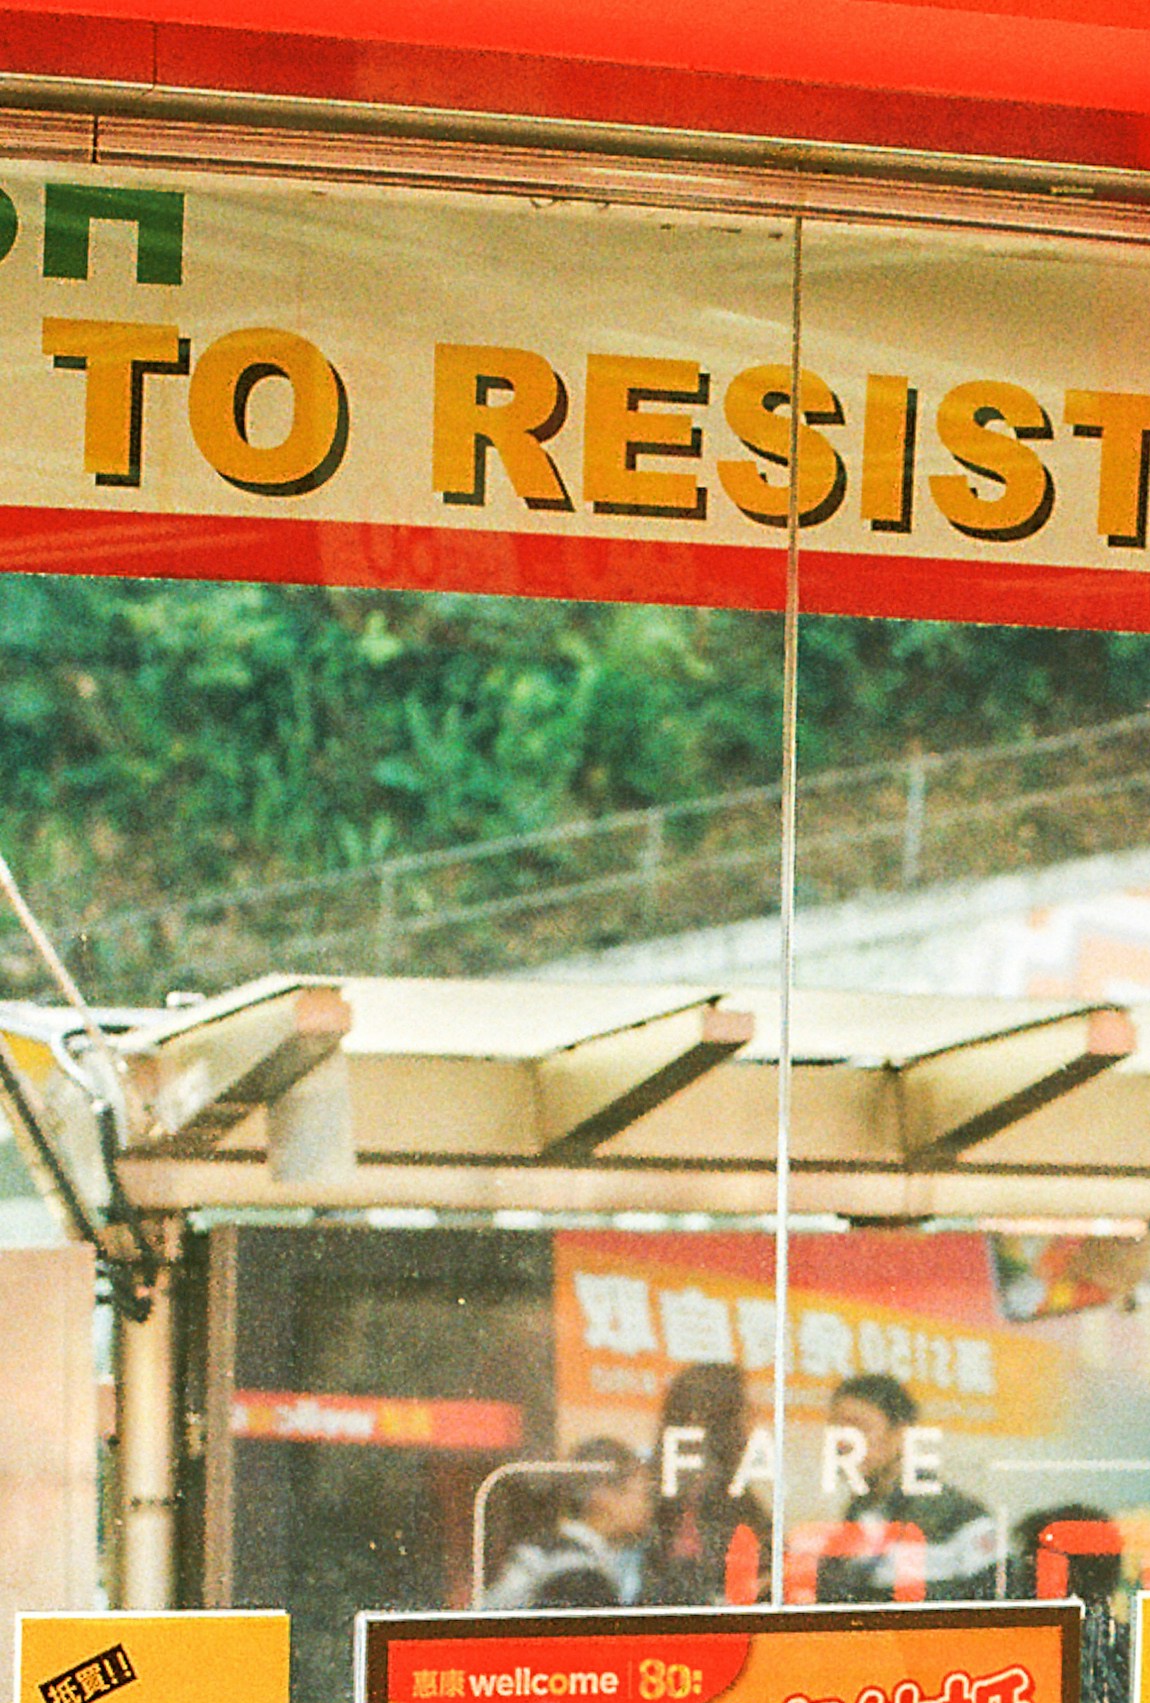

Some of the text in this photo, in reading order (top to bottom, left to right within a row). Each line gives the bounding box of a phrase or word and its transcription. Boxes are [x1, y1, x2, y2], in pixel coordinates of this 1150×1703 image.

[42, 316, 350, 497] TO
[660, 1426, 944, 1498] FARE
[412, 1669, 465, 1698] 惠康
[469, 1667, 620, 1697] wellcome
